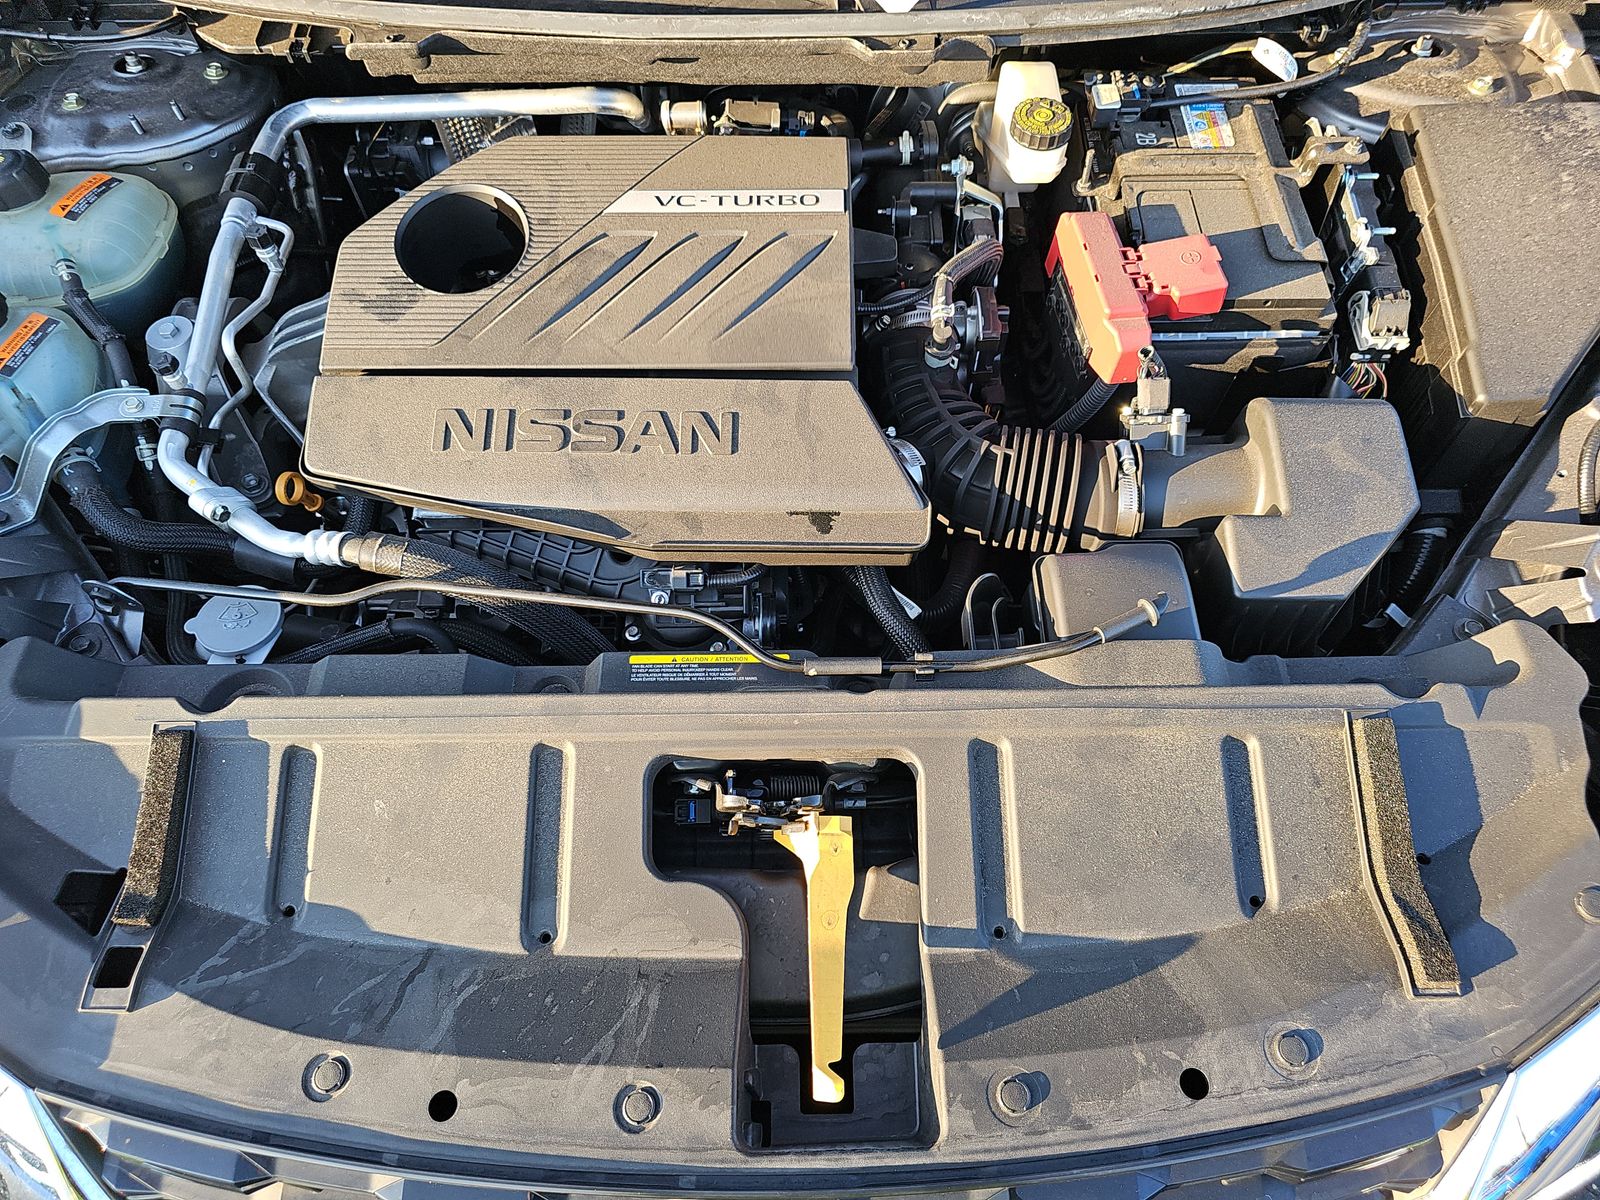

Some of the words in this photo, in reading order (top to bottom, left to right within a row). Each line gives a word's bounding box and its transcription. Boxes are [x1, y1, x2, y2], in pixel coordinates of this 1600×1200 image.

[1135, 132, 1157, 146] 2B
[654, 194, 820, 206] VC-TURBO
[431, 408, 739, 455] NISSAN
